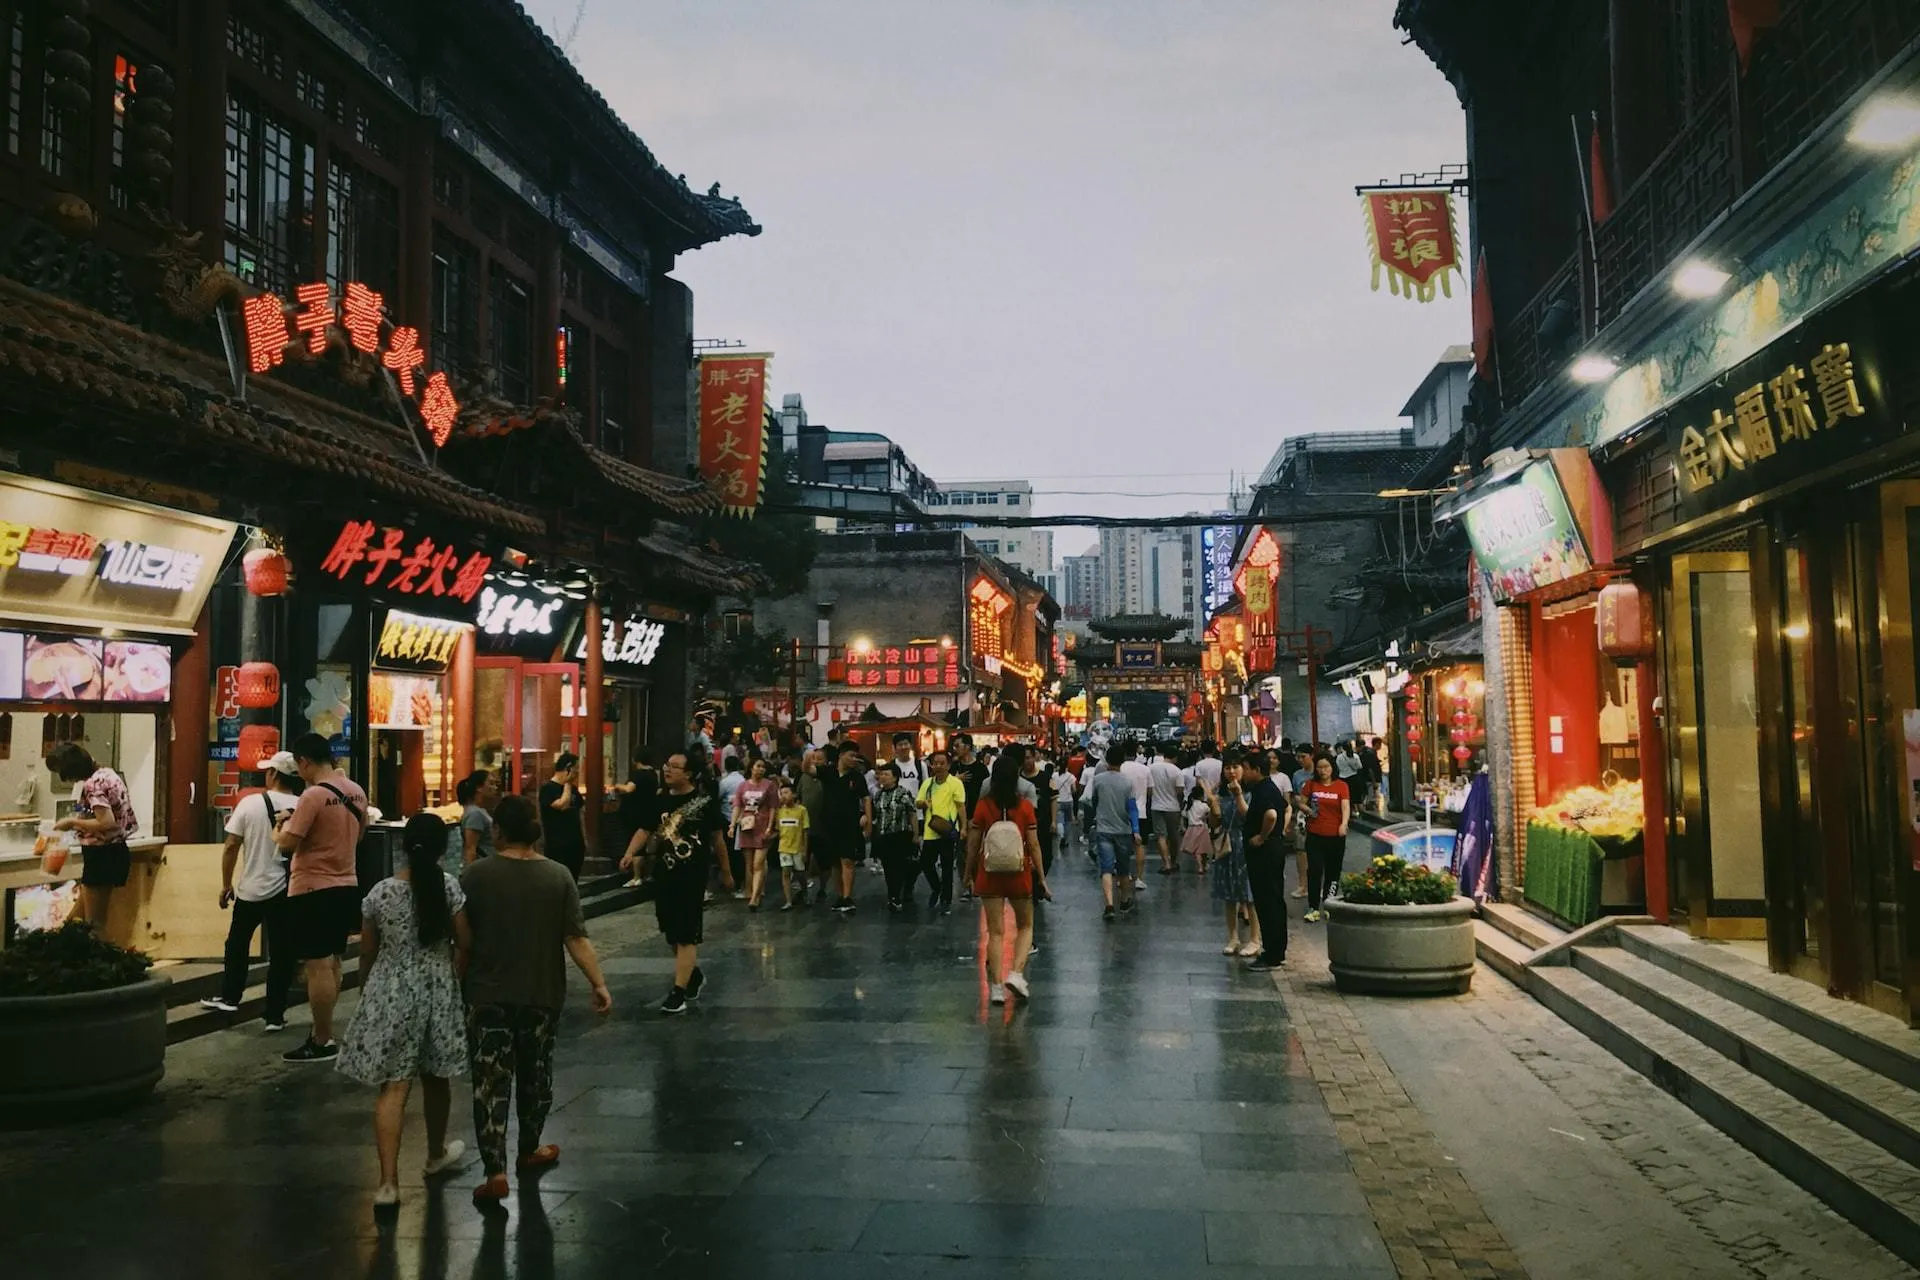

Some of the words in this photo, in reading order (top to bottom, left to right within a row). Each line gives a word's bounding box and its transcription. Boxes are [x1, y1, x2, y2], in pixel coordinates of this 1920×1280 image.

[707, 367, 760, 387] 胖子
[1679, 342, 1866, 494] 金大福珠寶
[711, 392, 752, 499] 老火锅
